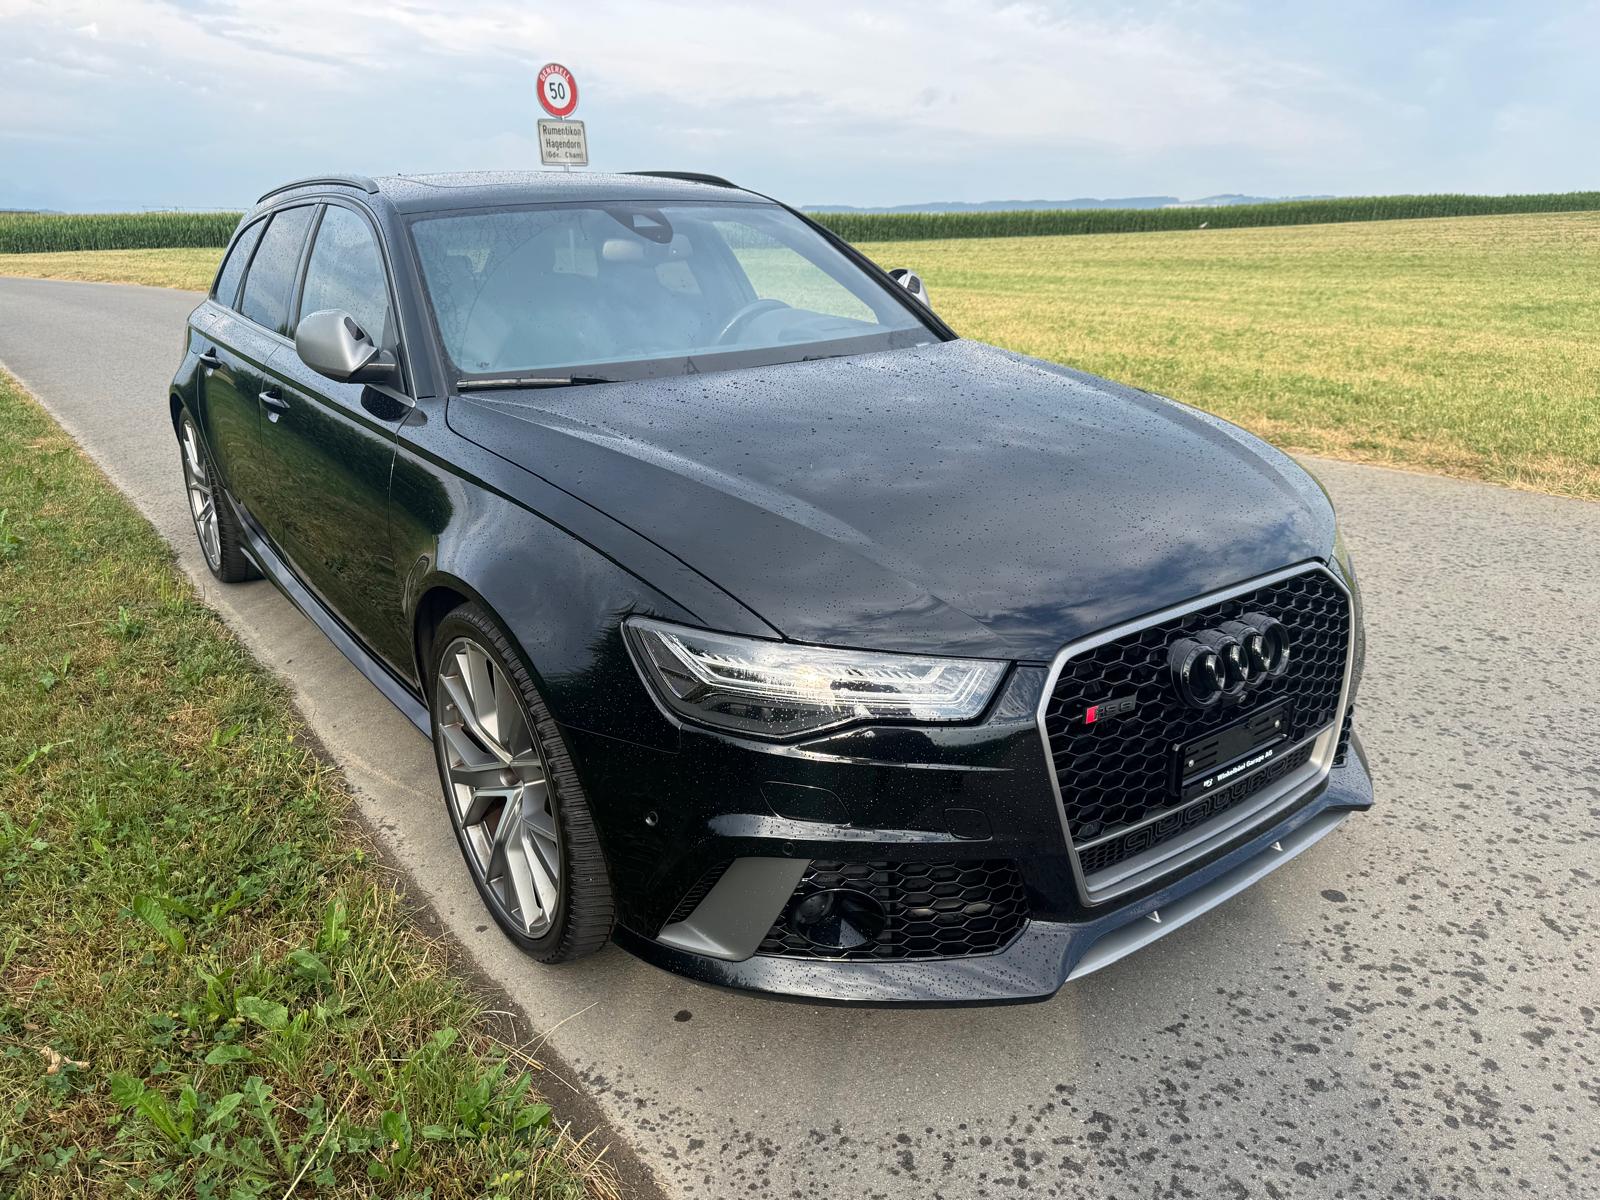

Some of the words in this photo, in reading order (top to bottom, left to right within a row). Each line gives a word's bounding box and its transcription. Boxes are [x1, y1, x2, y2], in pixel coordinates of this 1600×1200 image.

[540, 64, 570, 81] GENERELL
[549, 82, 565, 100] 50
[546, 138, 582, 151] Hagendorn
[1246, 754, 1265, 768] Garage
[1265, 749, 1273, 759] AG
[1123, 758, 1287, 851] quattro
